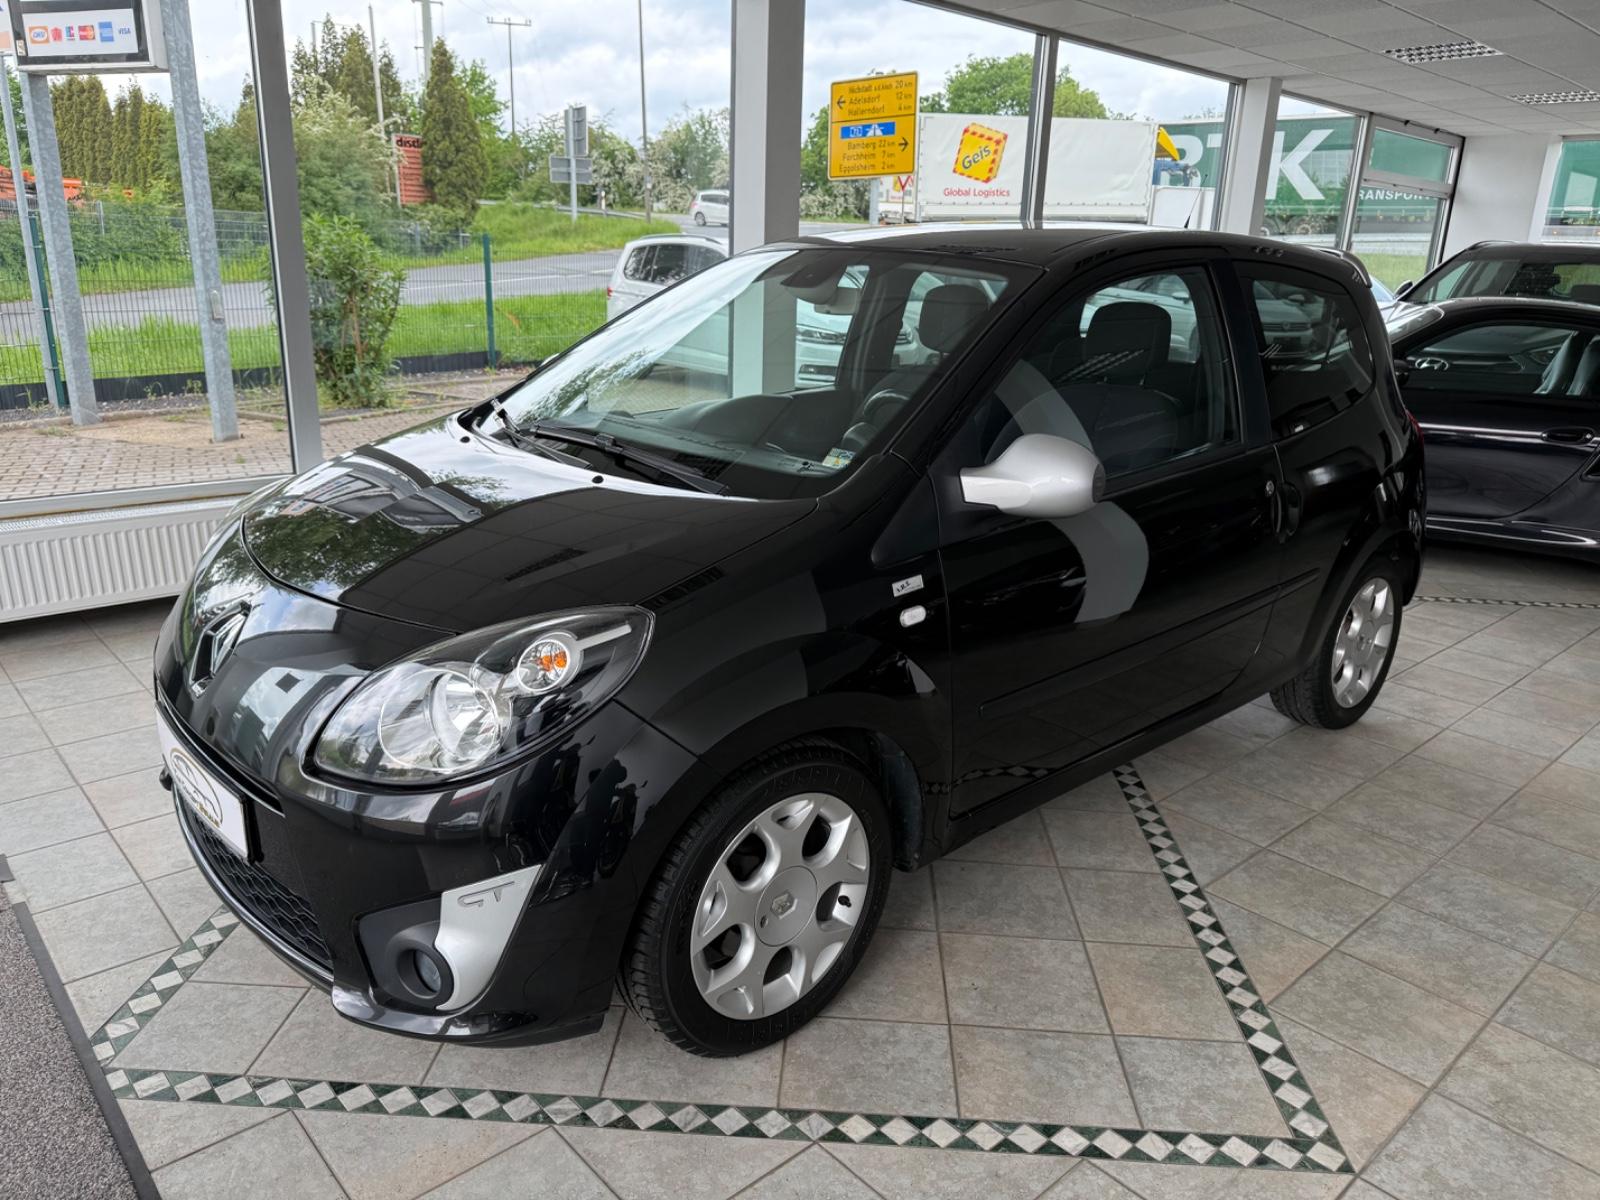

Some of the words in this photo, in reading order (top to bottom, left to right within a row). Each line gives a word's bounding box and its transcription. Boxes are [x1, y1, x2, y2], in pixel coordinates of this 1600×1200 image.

[847, 142, 876, 150] Bamberg
[842, 152, 876, 161] Forchheim
[962, 146, 991, 170] Geis
[943, 188, 971, 197] Global
[974, 188, 1010, 198] Logistics
[457, 881, 515, 908] GT
